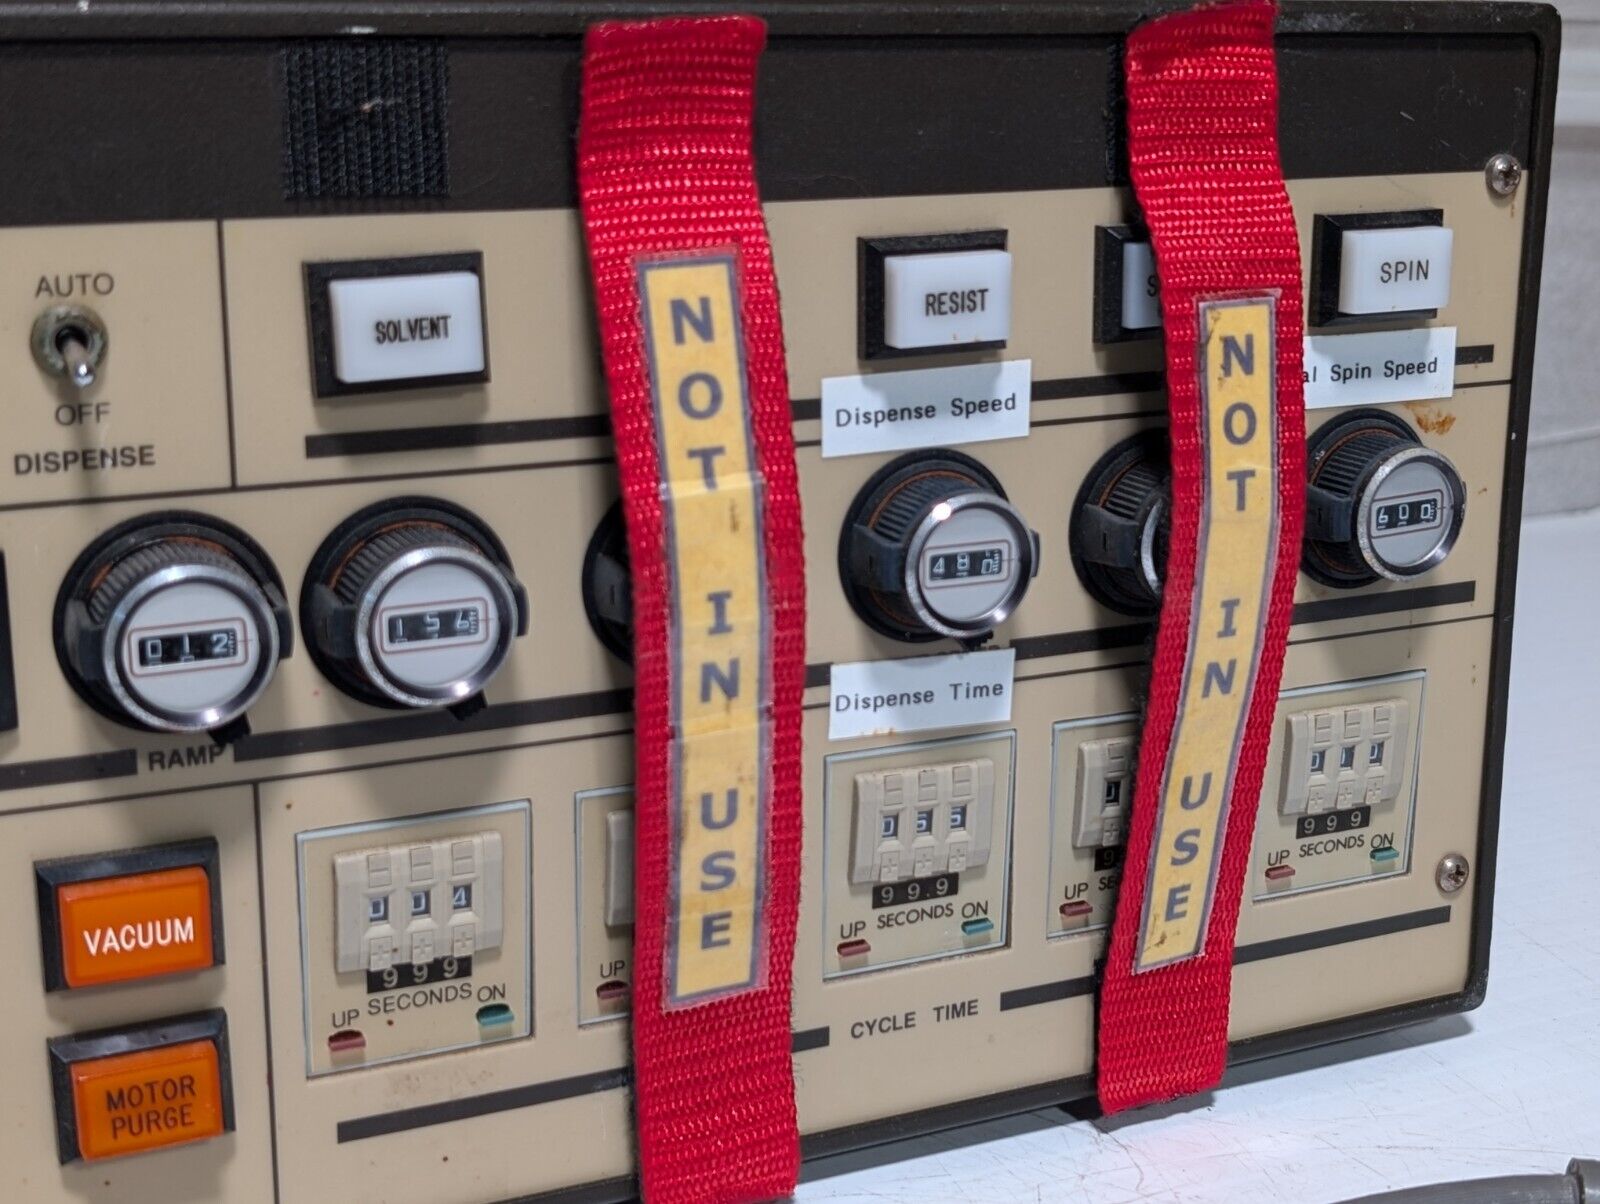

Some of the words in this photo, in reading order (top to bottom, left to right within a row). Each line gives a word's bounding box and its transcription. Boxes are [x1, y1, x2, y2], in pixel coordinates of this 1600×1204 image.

[35, 273, 115, 298] AUTO
[1380, 259, 1430, 285] SPIN
[925, 288, 990, 317] RESIST
[375, 315, 451, 345] SOLVENT
[1330, 363, 1372, 384] Spin
[1384, 357, 1438, 380] Speed
[671, 296, 725, 490] NOT
[836, 401, 937, 428] Dispense
[950, 393, 1017, 421] Speed
[55, 403, 111, 427] OFF
[1221, 333, 1257, 512] NOT
[14, 445, 156, 475] DISPENSE
[700, 591, 740, 703] IN
[1200, 598, 1241, 699] IN
[835, 686, 935, 714] Dispense
[949, 679, 1004, 701] Time
[149, 745, 224, 771] RAMP
[1164, 773, 1212, 923] USE
[1268, 850, 1291, 866] UP
[1299, 834, 1364, 858] SECONDS
[1370, 832, 1394, 848] ON
[700, 789, 739, 951] USE
[1064, 882, 1089, 900] UP
[83, 916, 194, 957] VACUUM
[840, 921, 866, 939] UP
[877, 903, 954, 929] SECONDS
[961, 901, 989, 918] ON
[600, 960, 625, 978] UP
[332, 1009, 360, 1028] UP
[367, 982, 472, 1016] SECONDS
[477, 984, 506, 1003] ON
[850, 1010, 917, 1040] CYCLE
[933, 999, 979, 1024] TIME
[107, 1075, 196, 1112] MOTOR
[112, 1105, 194, 1140] PURGE
